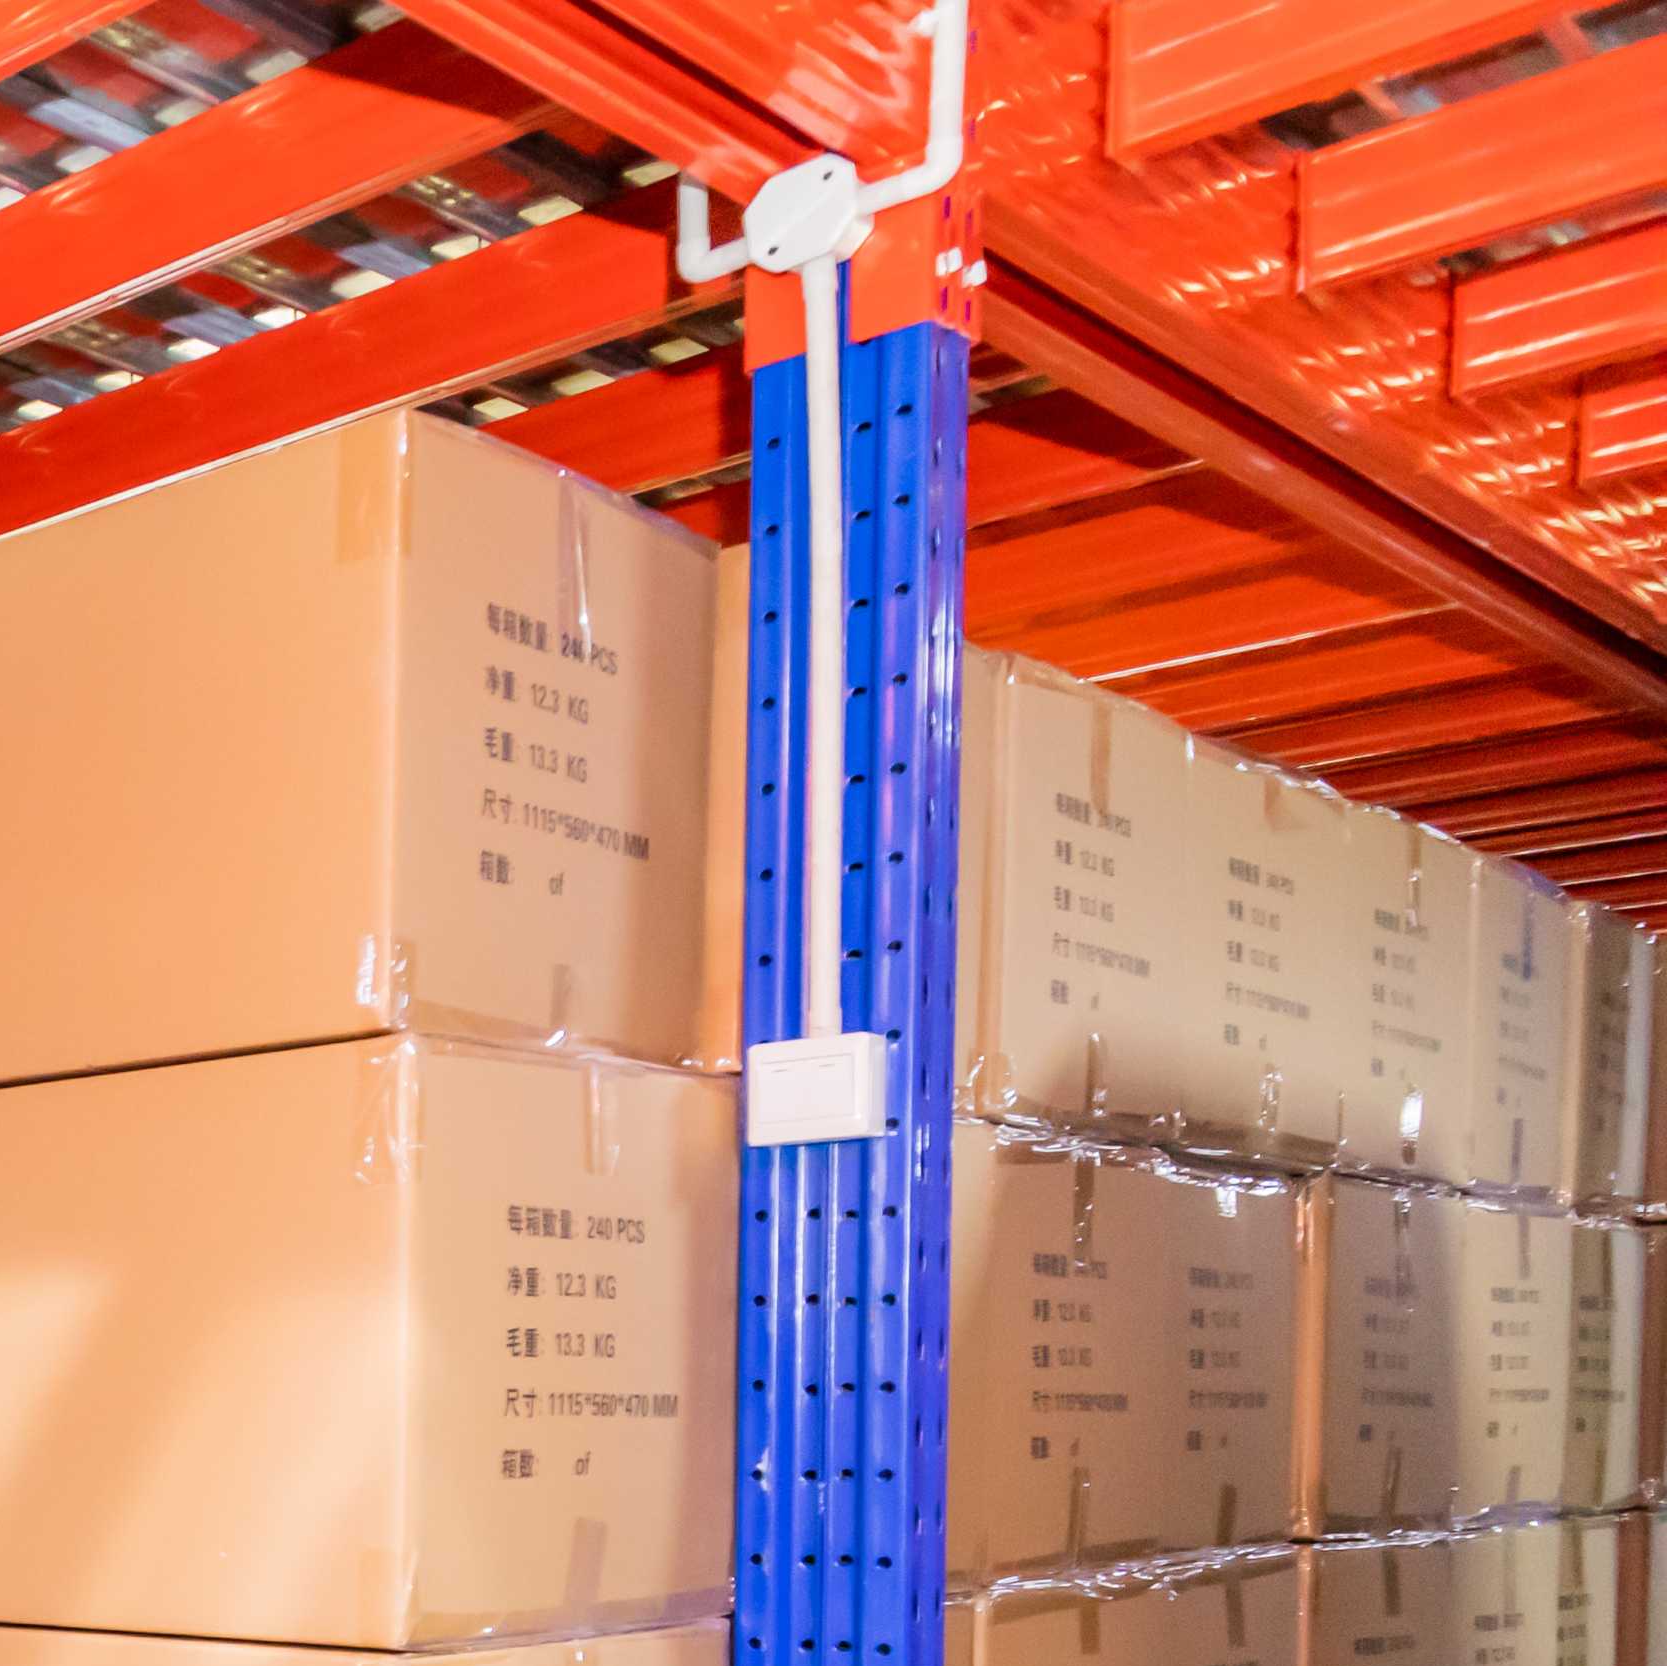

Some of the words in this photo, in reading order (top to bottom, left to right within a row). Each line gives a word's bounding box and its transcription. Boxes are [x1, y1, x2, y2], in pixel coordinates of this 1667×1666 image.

[531, 683, 559, 714] 12.3
[568, 695, 589, 725] KG
[529, 743, 557, 774] 13.3
[567, 752, 588, 783] KG
[624, 831, 650, 861] MM
[549, 872, 564, 896] of
[587, 1215, 613, 1240] 240
[617, 1217, 646, 1244] PCS
[556, 1273, 587, 1297] 12.3
[595, 1275, 617, 1300] KG
[555, 1332, 586, 1358] 13.3
[594, 1333, 616, 1358] KG
[653, 1394, 678, 1418] MM
[575, 1451, 591, 1476] of
